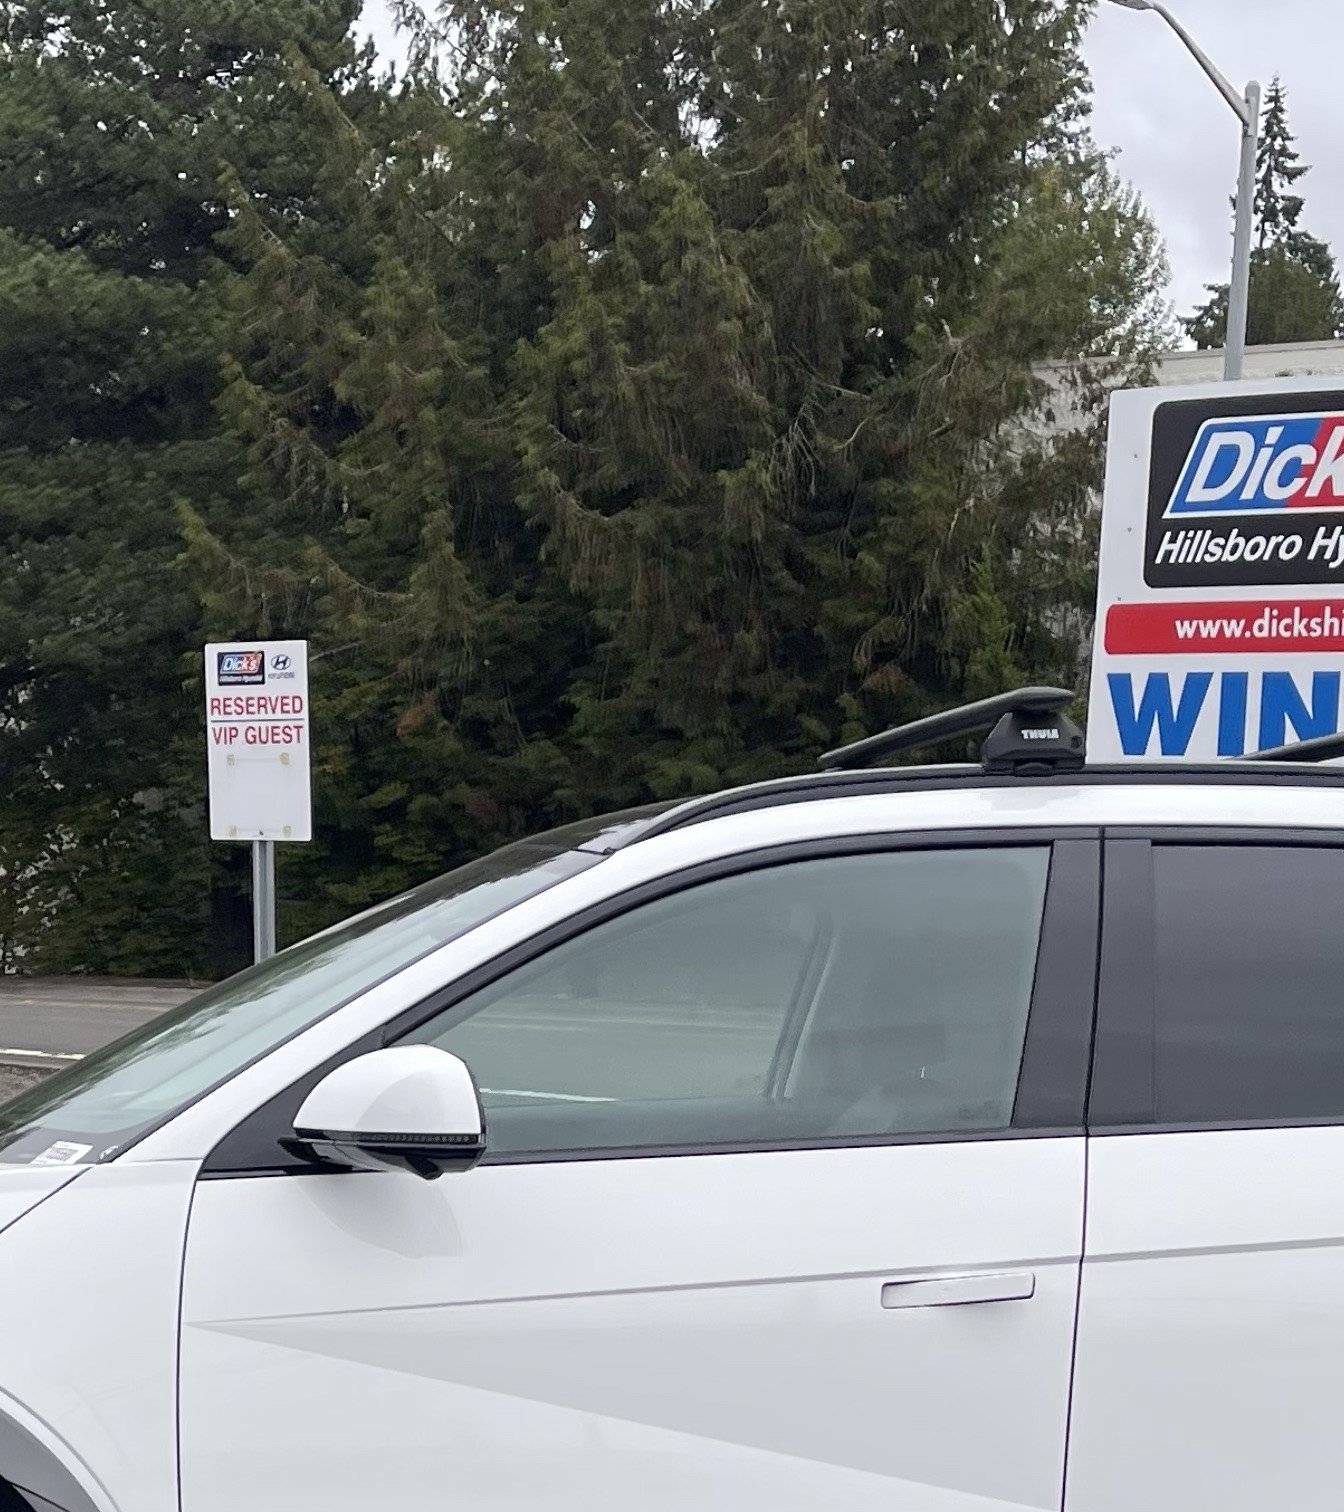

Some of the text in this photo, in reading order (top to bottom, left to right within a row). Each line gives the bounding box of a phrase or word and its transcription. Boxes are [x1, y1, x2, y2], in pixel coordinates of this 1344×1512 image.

[1155, 527, 1304, 564] Hillsboro
[210, 695, 303, 716] RESERVED
[211, 725, 304, 745] VIP GUEST
